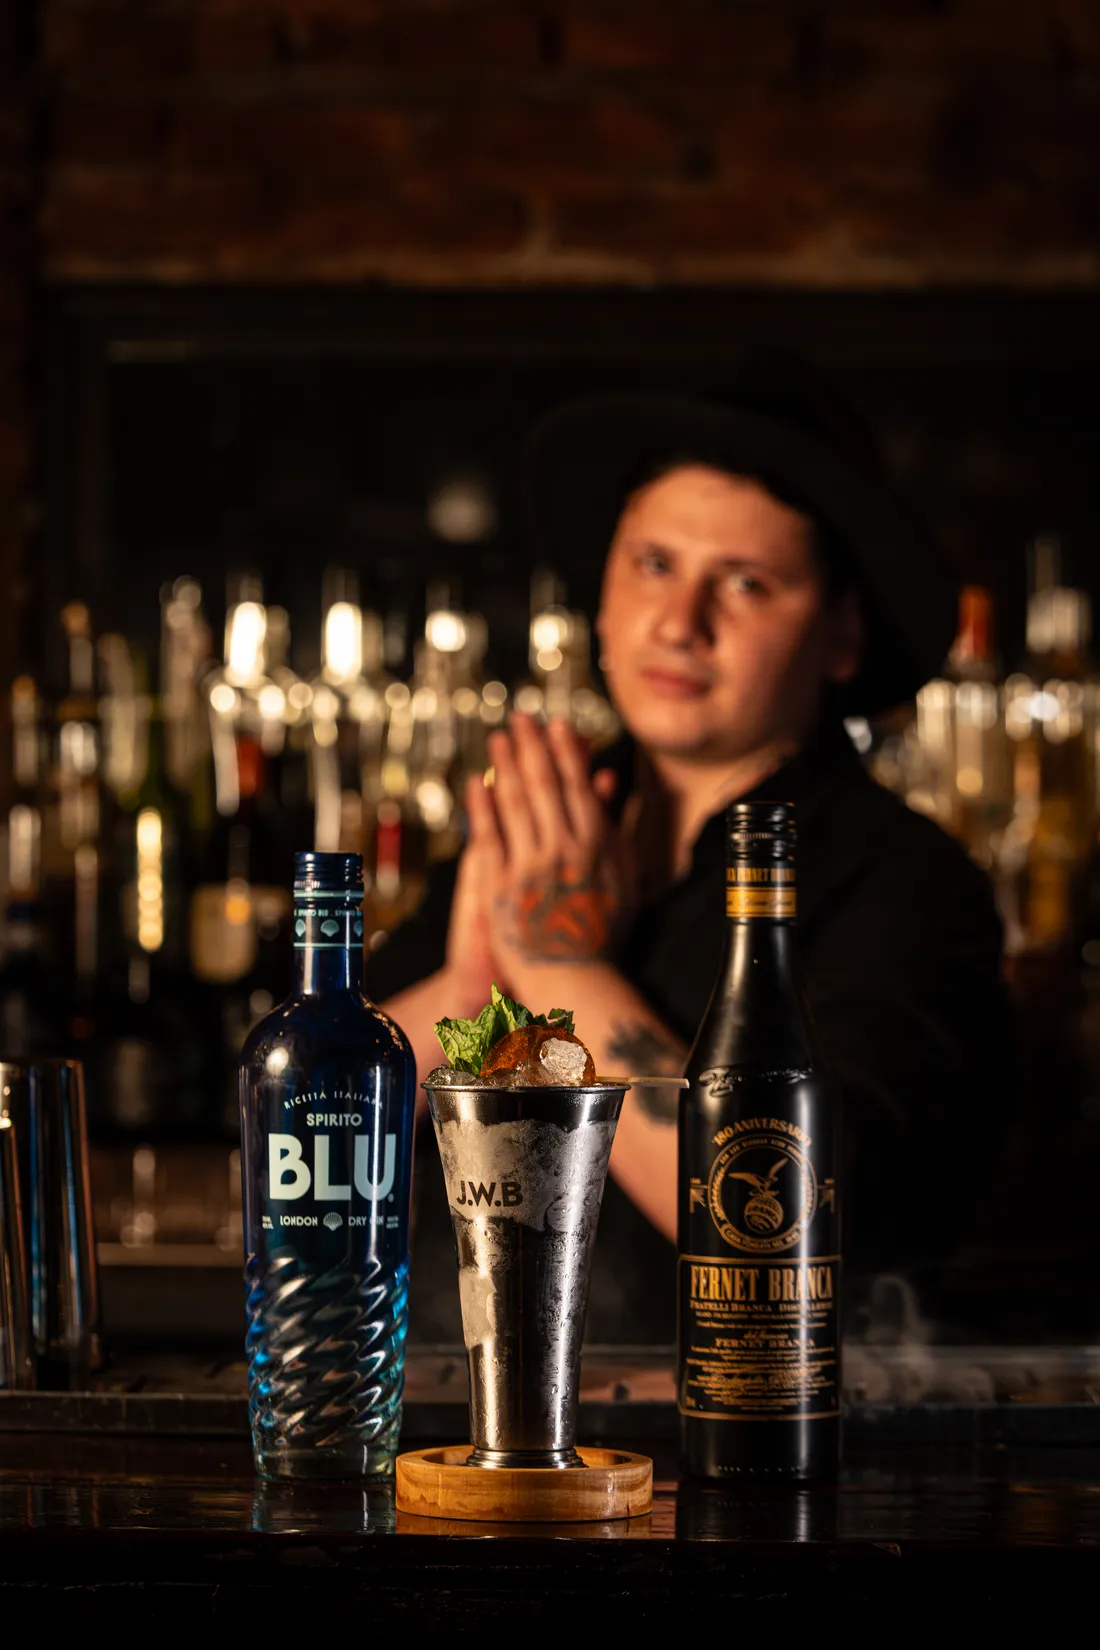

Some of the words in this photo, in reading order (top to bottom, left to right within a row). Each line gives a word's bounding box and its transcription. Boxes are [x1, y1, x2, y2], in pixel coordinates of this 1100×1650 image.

[306, 1113, 362, 1127] SPIRITO
[268, 1133, 396, 1201] BLU
[456, 1180, 523, 1207] J.W.B
[280, 1215, 318, 1226] LONDON
[348, 1216, 367, 1227] DRY
[690, 1265, 759, 1300] FERNET
[768, 1266, 832, 1301] BRANCA
